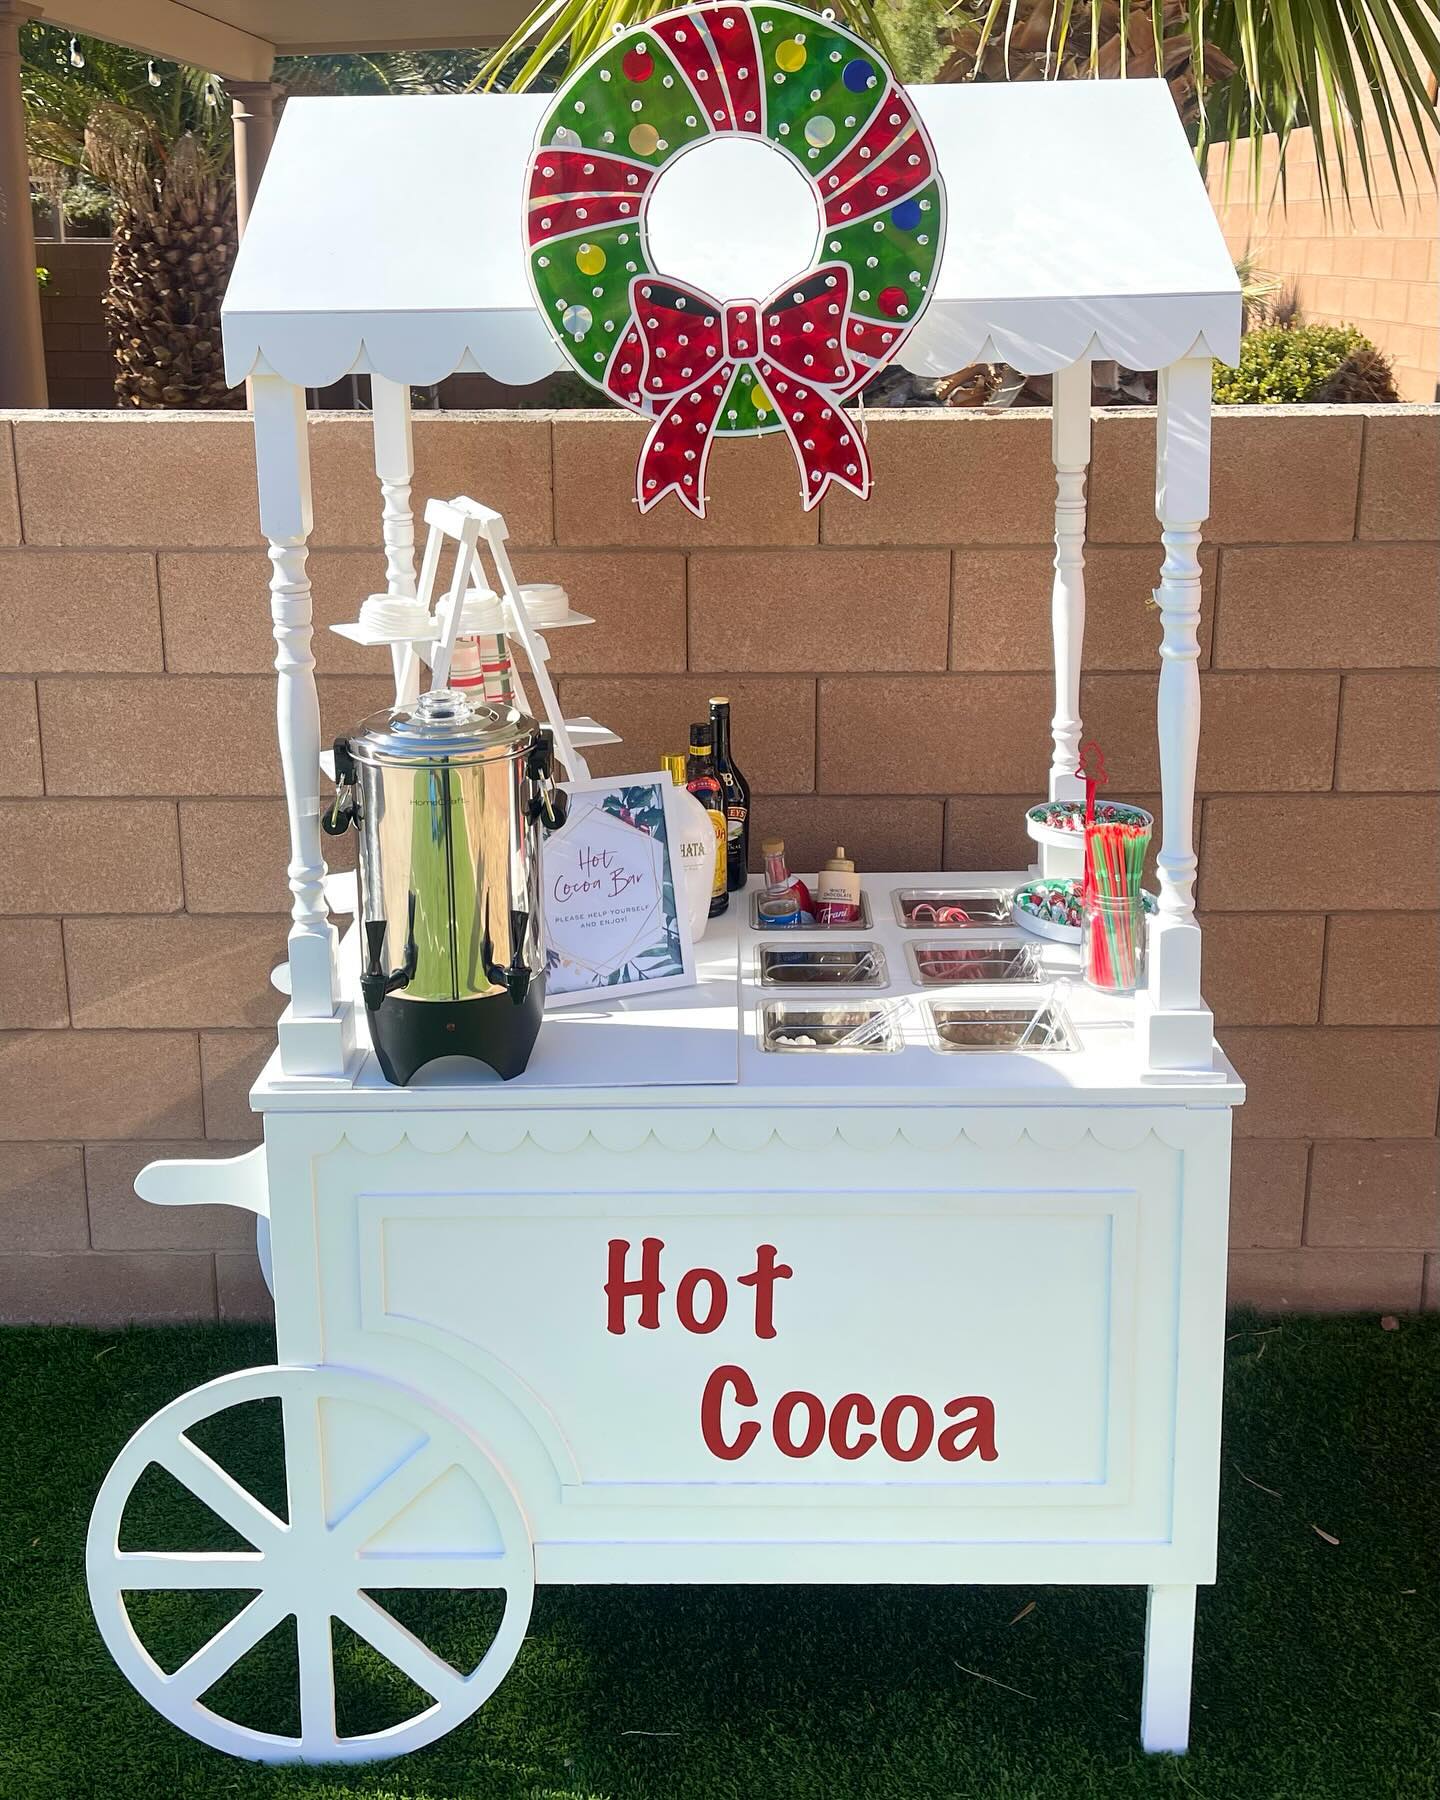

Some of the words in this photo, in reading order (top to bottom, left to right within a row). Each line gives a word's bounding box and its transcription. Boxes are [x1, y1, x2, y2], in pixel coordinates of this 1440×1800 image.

[409, 796, 465, 806] HomeCaft
[728, 808, 745, 818] EYS
[579, 846, 618, 878] Hot
[554, 874, 601, 903] Cocoa
[608, 867, 643, 898] Bar
[555, 913, 585, 923] PLEASE
[588, 910, 608, 919] HELP
[610, 904, 650, 916] YOURSELF
[580, 921, 597, 929] AND
[600, 916, 628, 927] ENJOY!
[603, 1237, 794, 1340] Hot
[700, 1364, 999, 1462] Cocoa
